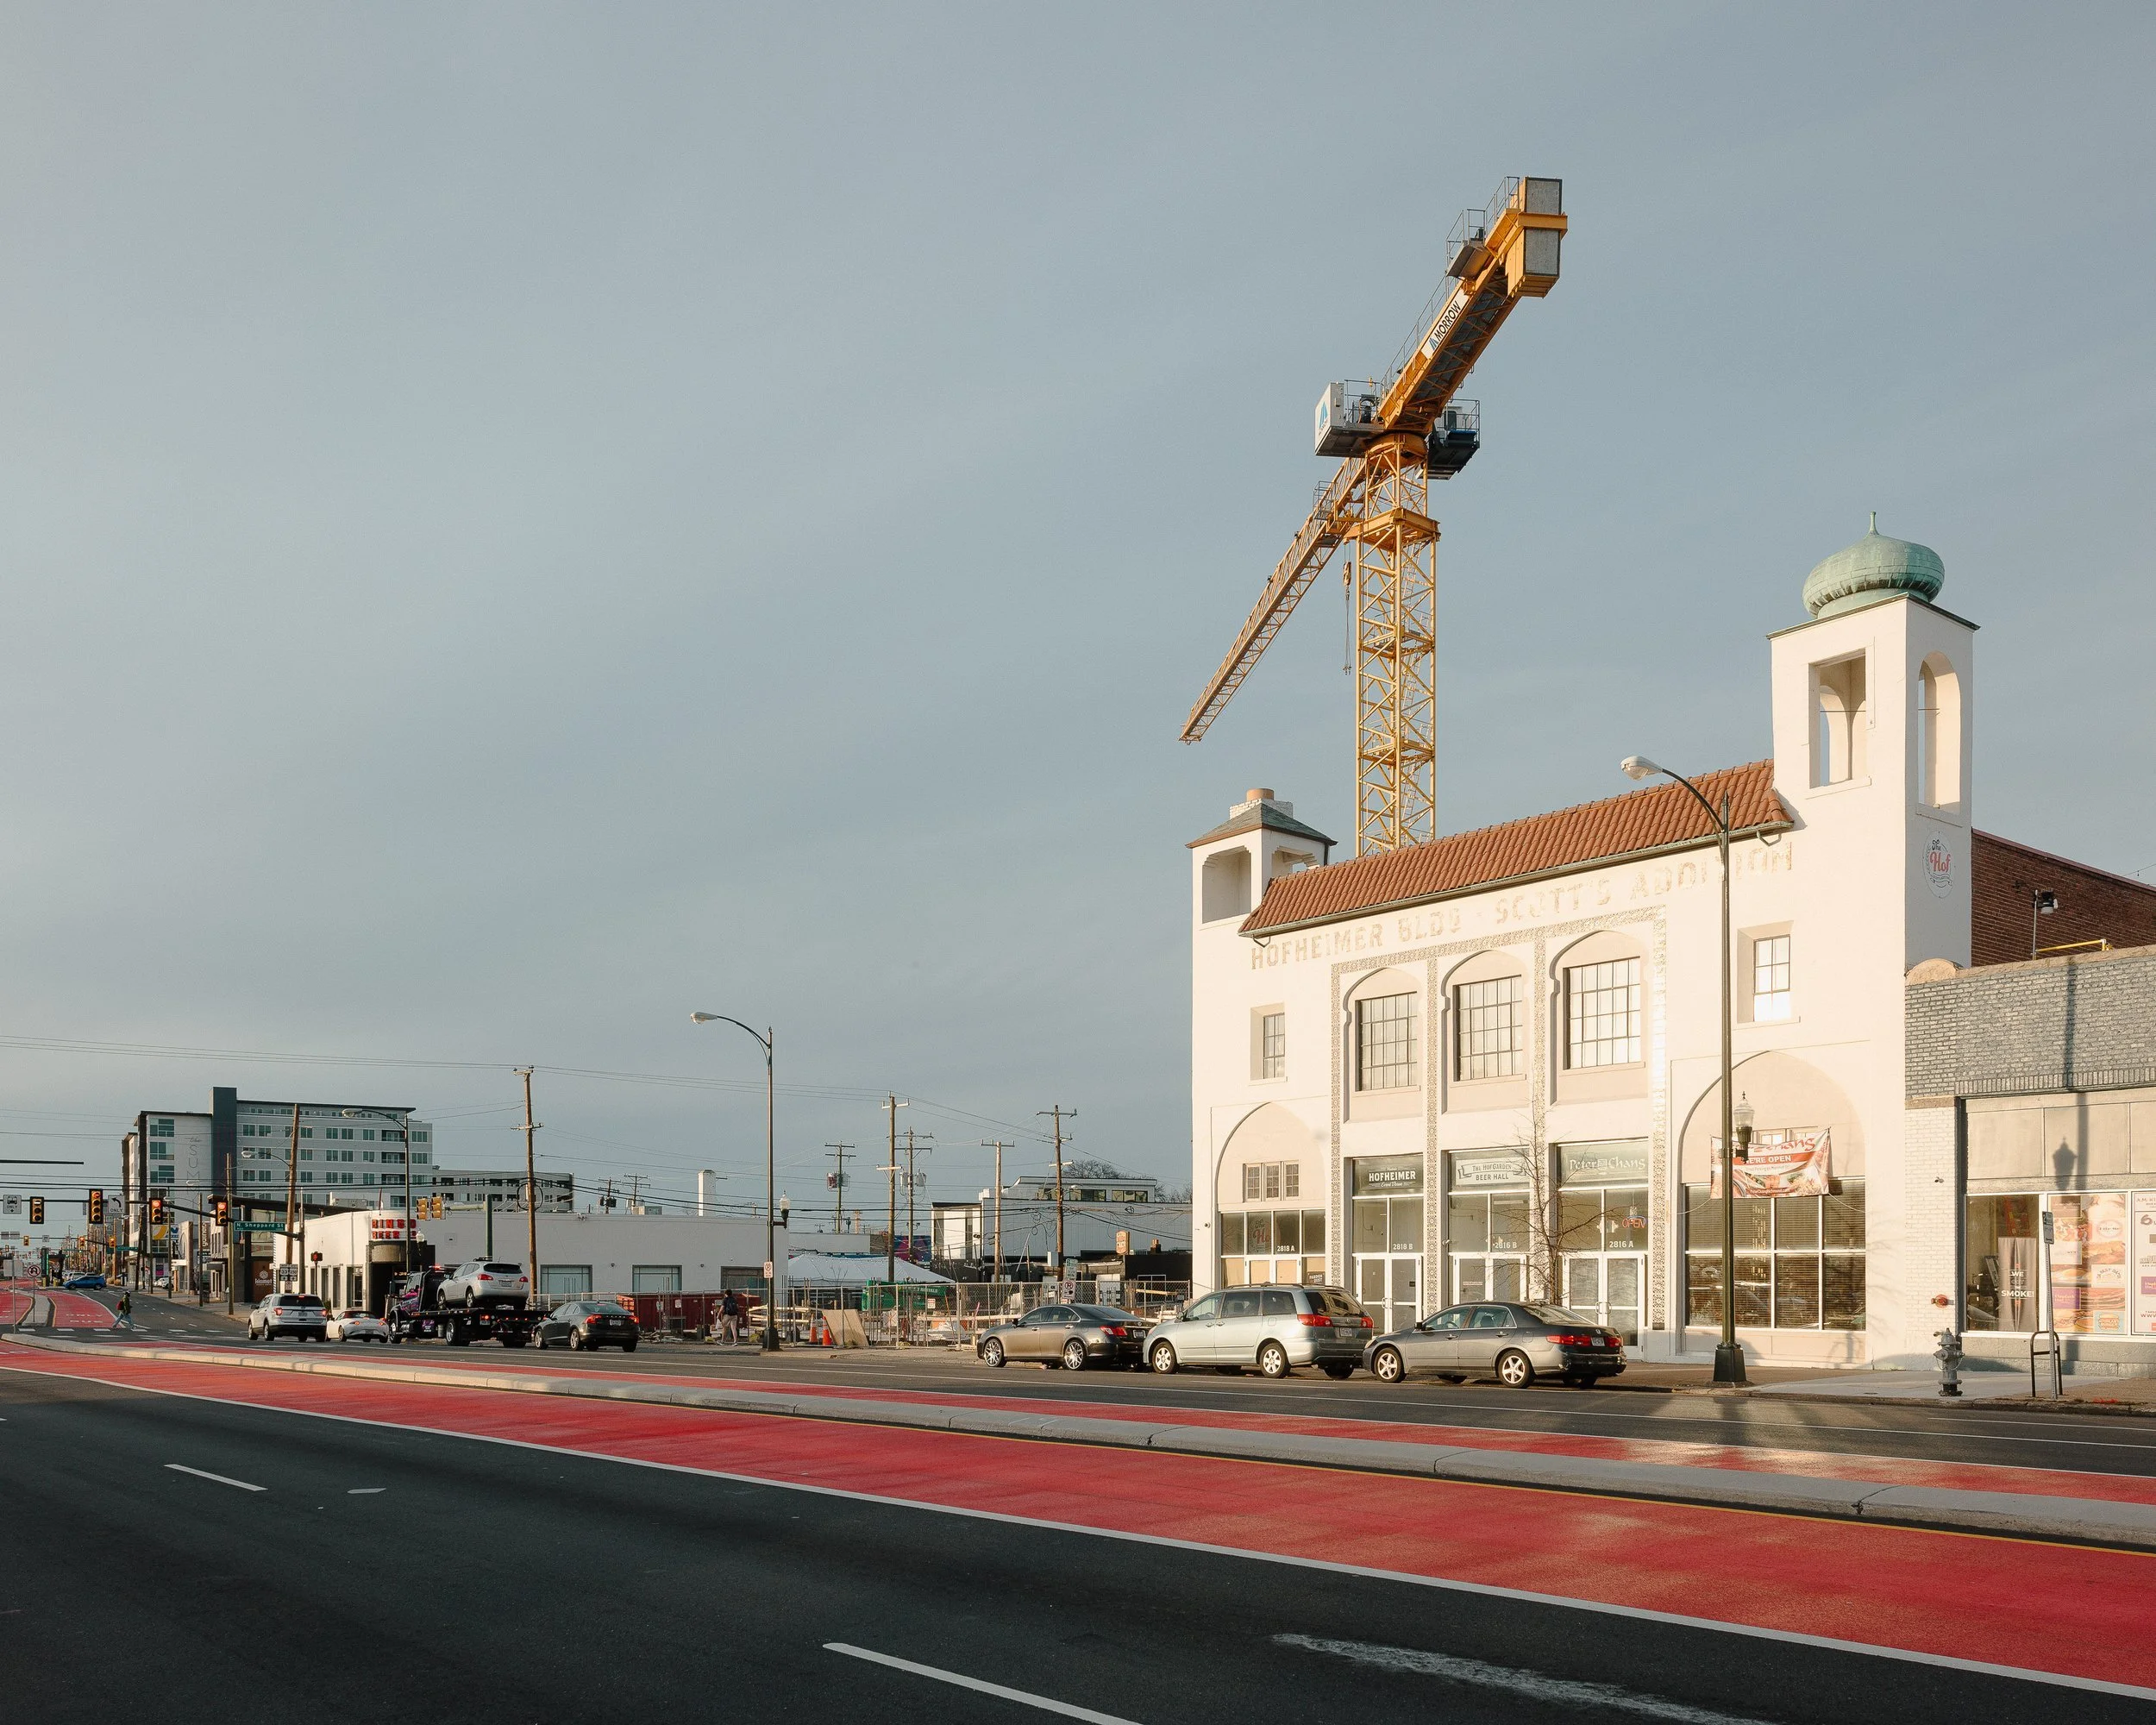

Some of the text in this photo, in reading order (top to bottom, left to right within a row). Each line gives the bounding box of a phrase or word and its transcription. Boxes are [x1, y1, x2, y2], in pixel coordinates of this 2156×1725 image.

[1434, 300, 1461, 342] MORROW
[1932, 839, 1941, 851] The
[1929, 851, 1951, 873] Hof
[1250, 923, 1383, 969] HOFHEIMER
[1569, 1159, 1596, 1170] Peter
[1369, 1170, 1416, 1182] HOFHEIMER
[372, 1219, 417, 1229] BINGO
[1621, 1218, 1645, 1228] OPEN
[372, 1230, 400, 1239] BEER
